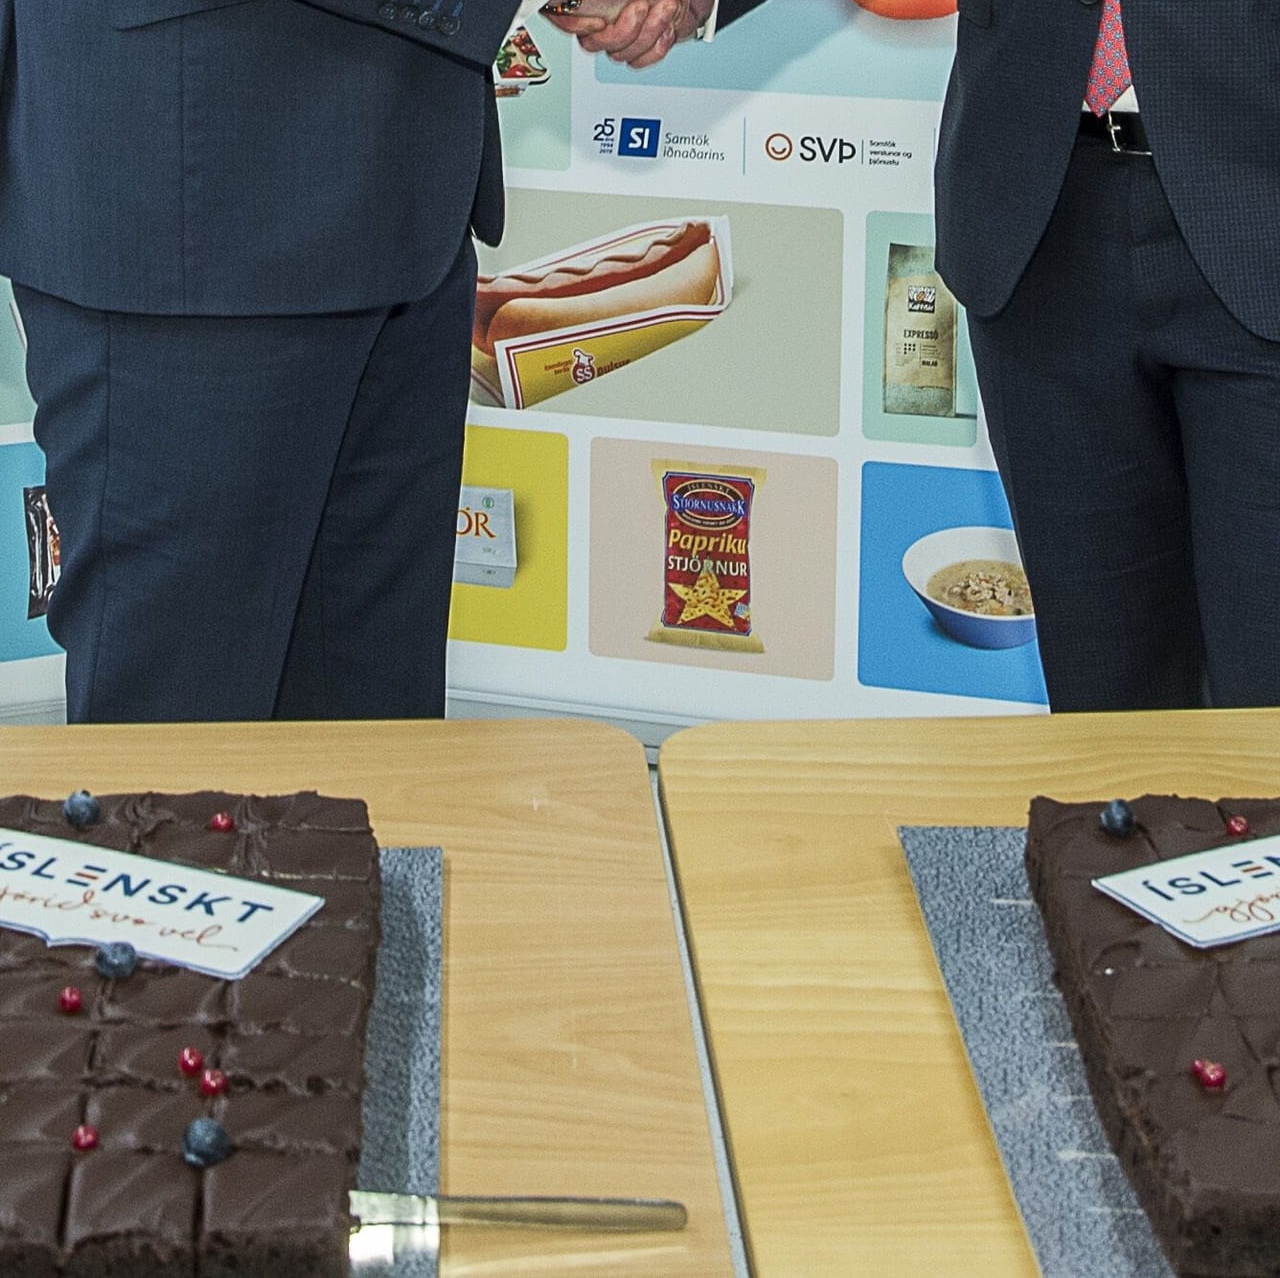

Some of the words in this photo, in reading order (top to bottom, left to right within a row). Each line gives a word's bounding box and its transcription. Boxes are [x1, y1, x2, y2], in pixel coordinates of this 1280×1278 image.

[593, 118, 616, 142] 25
[628, 127, 650, 150] SI
[664, 131, 710, 147] Samtök
[663, 145, 725, 162] iðnaðarins
[799, 136, 857, 164] SVÞ
[869, 140, 896, 148] Samtök
[902, 151, 912, 159] og
[576, 366, 593, 382] SS
[668, 554, 748, 576] STJÖRNUR
[89, 904, 158, 928] svo
[159, 924, 238, 951] vel
